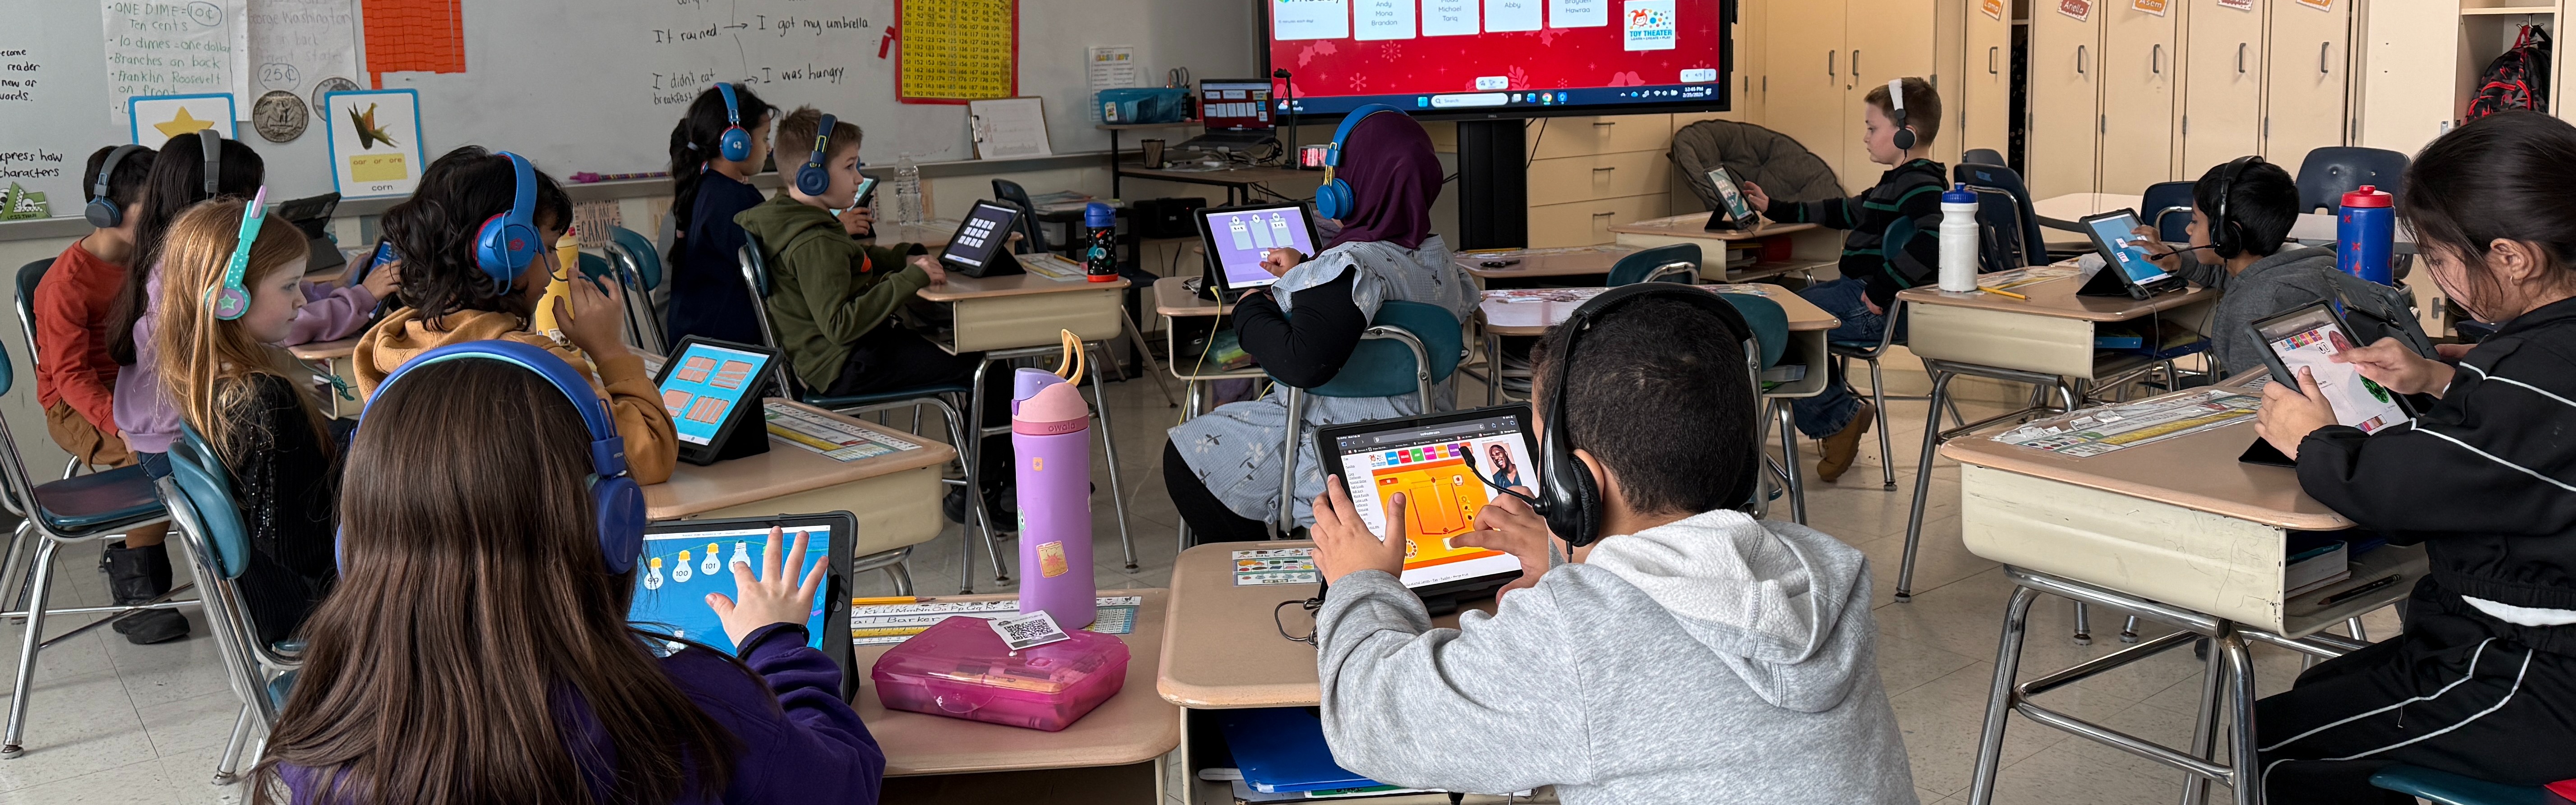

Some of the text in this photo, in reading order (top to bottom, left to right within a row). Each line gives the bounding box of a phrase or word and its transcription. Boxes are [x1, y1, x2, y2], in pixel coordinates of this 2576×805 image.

[115, 2, 140, 15] ONE
[146, 3, 179, 17] DIME
[2064, 2, 2084, 14] Ariella
[129, 18, 188, 32] Ten cents
[757, 15, 766, 30] I
[778, 16, 795, 37] got
[804, 19, 821, 35] my
[120, 35, 131, 46] 10
[136, 37, 170, 49] dimes
[204, 41, 230, 53] dollar
[8, 61, 40, 71] reader
[115, 53, 221, 69] Branches on back
[119, 70, 221, 84] Franklin Roosevelt
[653, 68, 716, 90] I didn't eat
[762, 67, 772, 83] I
[782, 69, 802, 81] was
[1, 79, 37, 87] new or
[119, 84, 133, 94] on
[654, 91, 693, 105] breakfast
[0, 148, 63, 165] xpress how
[1048, 422, 1076, 432] owala
